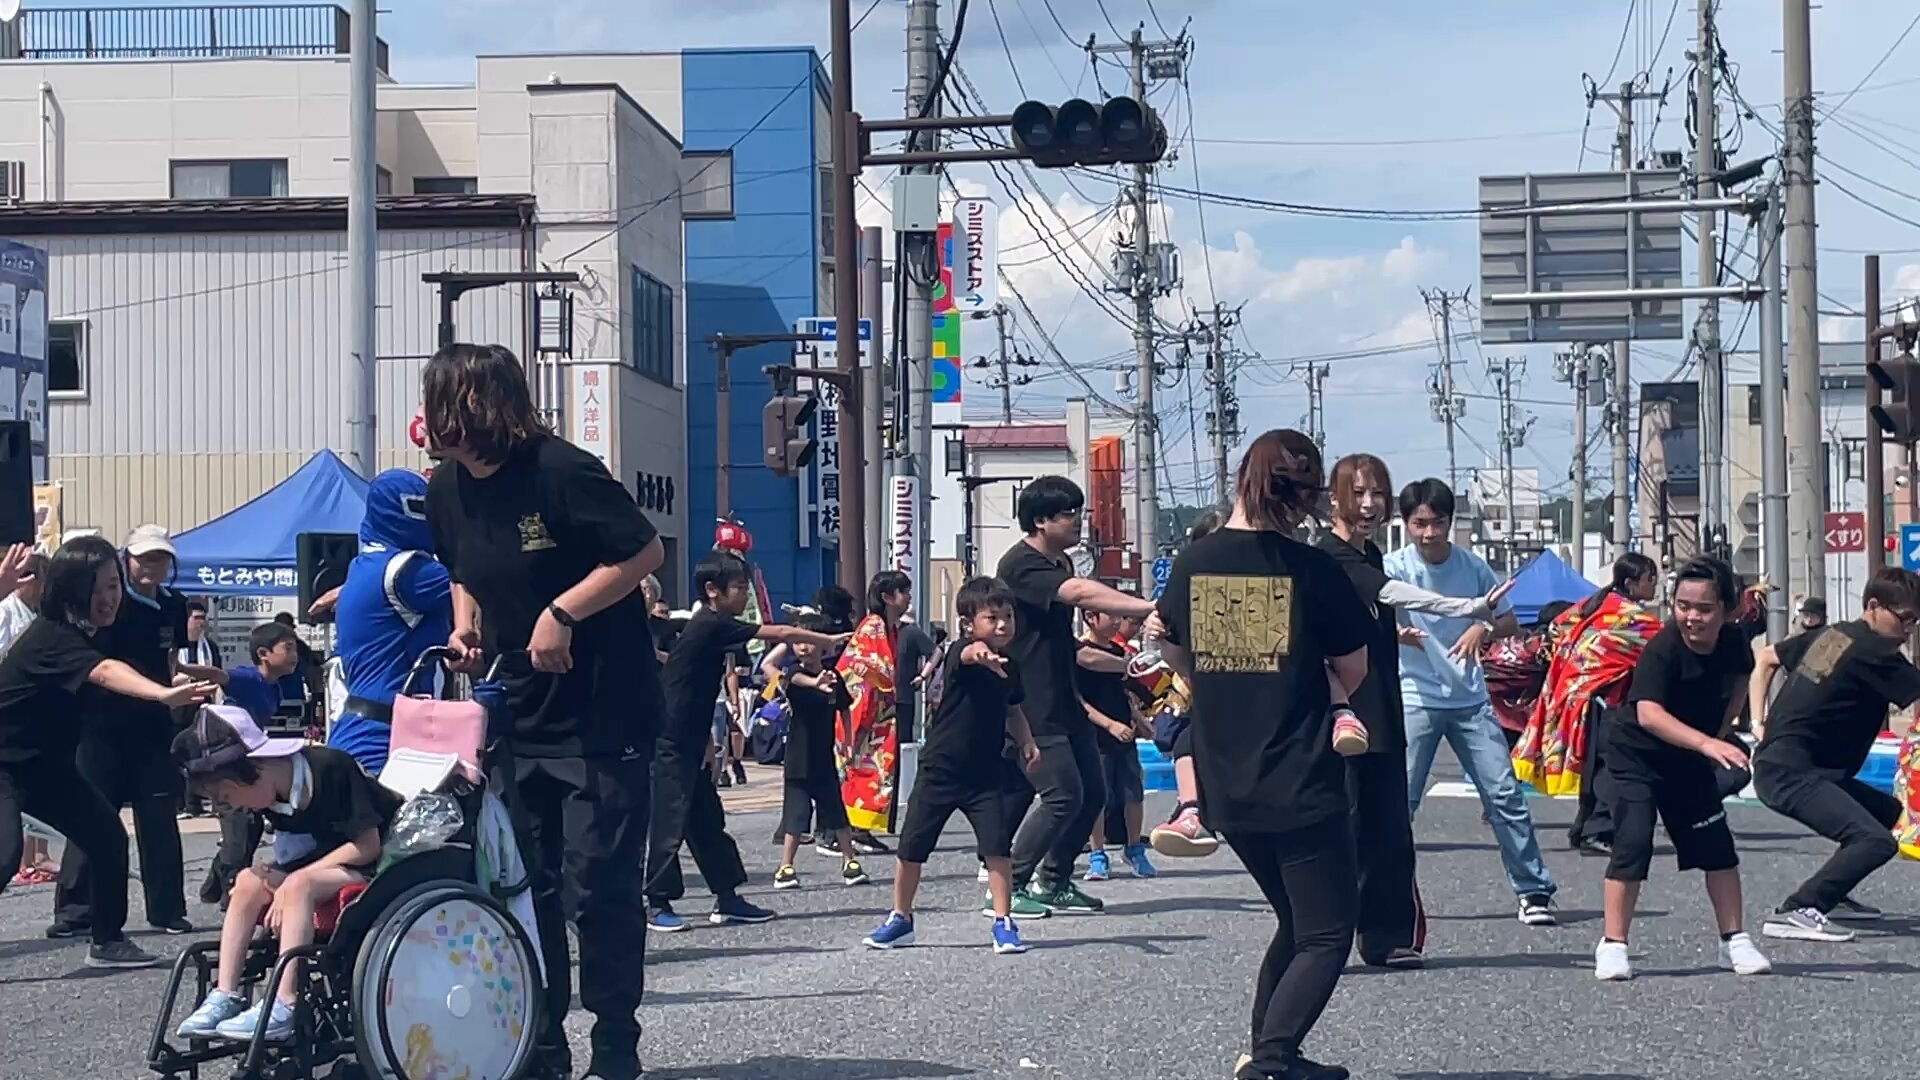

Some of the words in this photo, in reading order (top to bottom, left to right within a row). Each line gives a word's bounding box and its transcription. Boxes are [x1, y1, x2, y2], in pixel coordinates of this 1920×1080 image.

[967, 203, 983, 292] シミズストア
[583, 370, 600, 442] 婦人洋品
[1825, 528, 1863, 547] くすり
[197, 565, 298, 587] もとみや商
